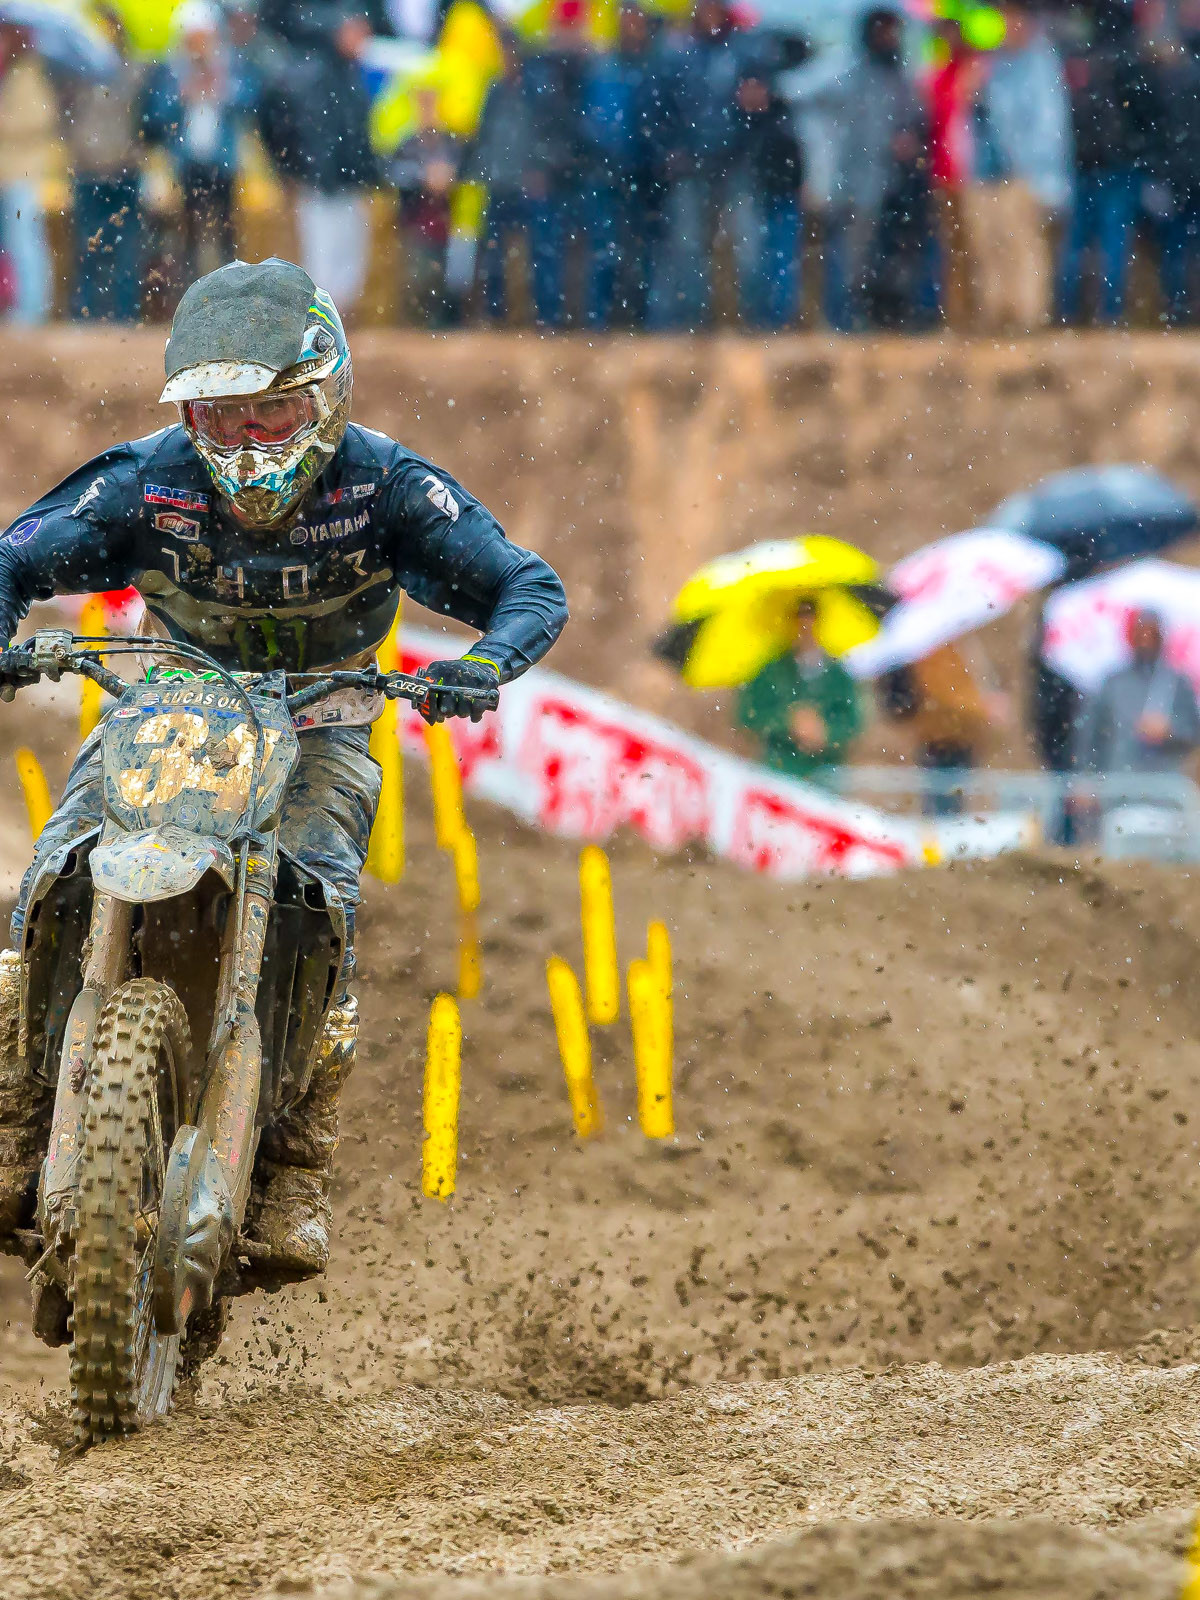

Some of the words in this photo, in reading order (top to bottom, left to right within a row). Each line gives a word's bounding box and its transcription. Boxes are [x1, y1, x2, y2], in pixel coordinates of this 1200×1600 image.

[309, 509, 371, 543] YAMAHA
[387, 678, 430, 697] ARC
[161, 692, 215, 706] LUCAS
